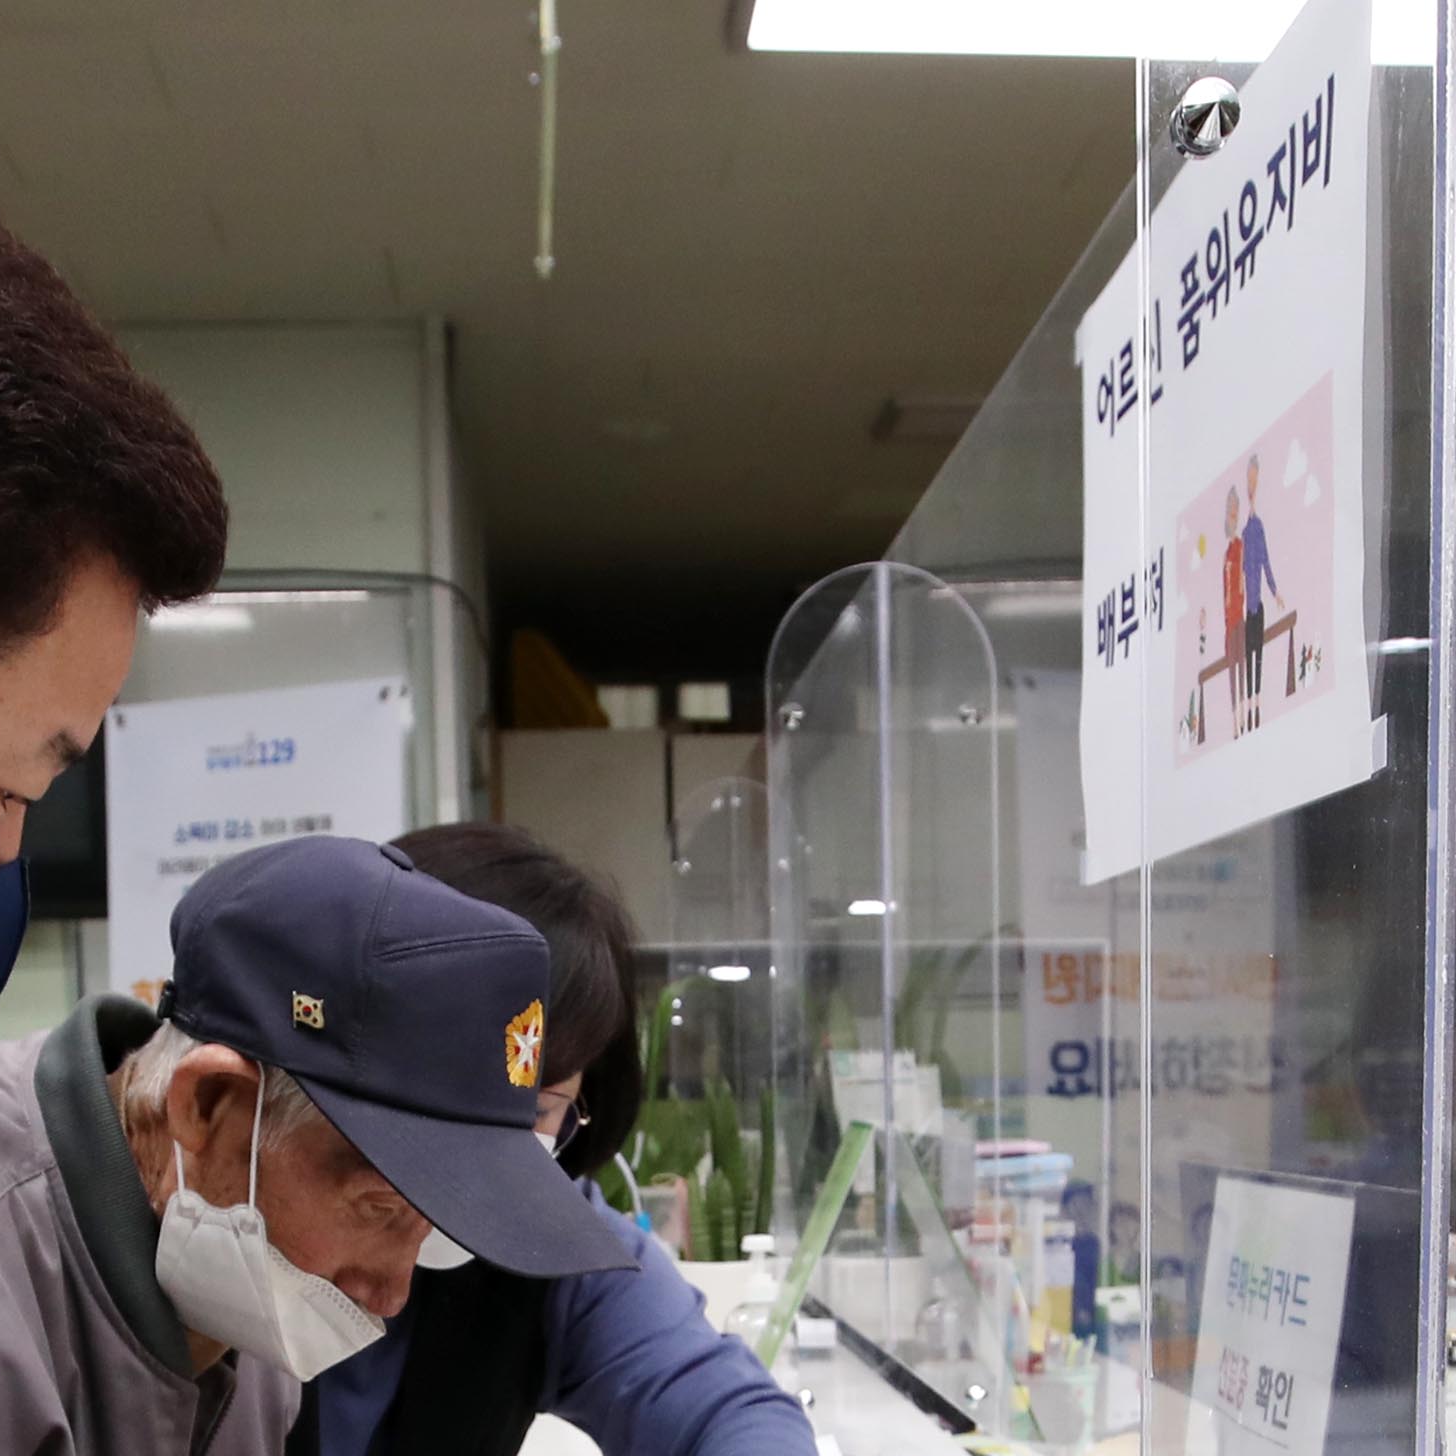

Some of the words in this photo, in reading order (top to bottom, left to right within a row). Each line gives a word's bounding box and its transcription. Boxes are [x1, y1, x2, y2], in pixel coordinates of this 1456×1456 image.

[1177, 72, 1335, 370] 품위유지비
[258, 738, 296, 765] 129
[1255, 1364, 1294, 1431] 확인
